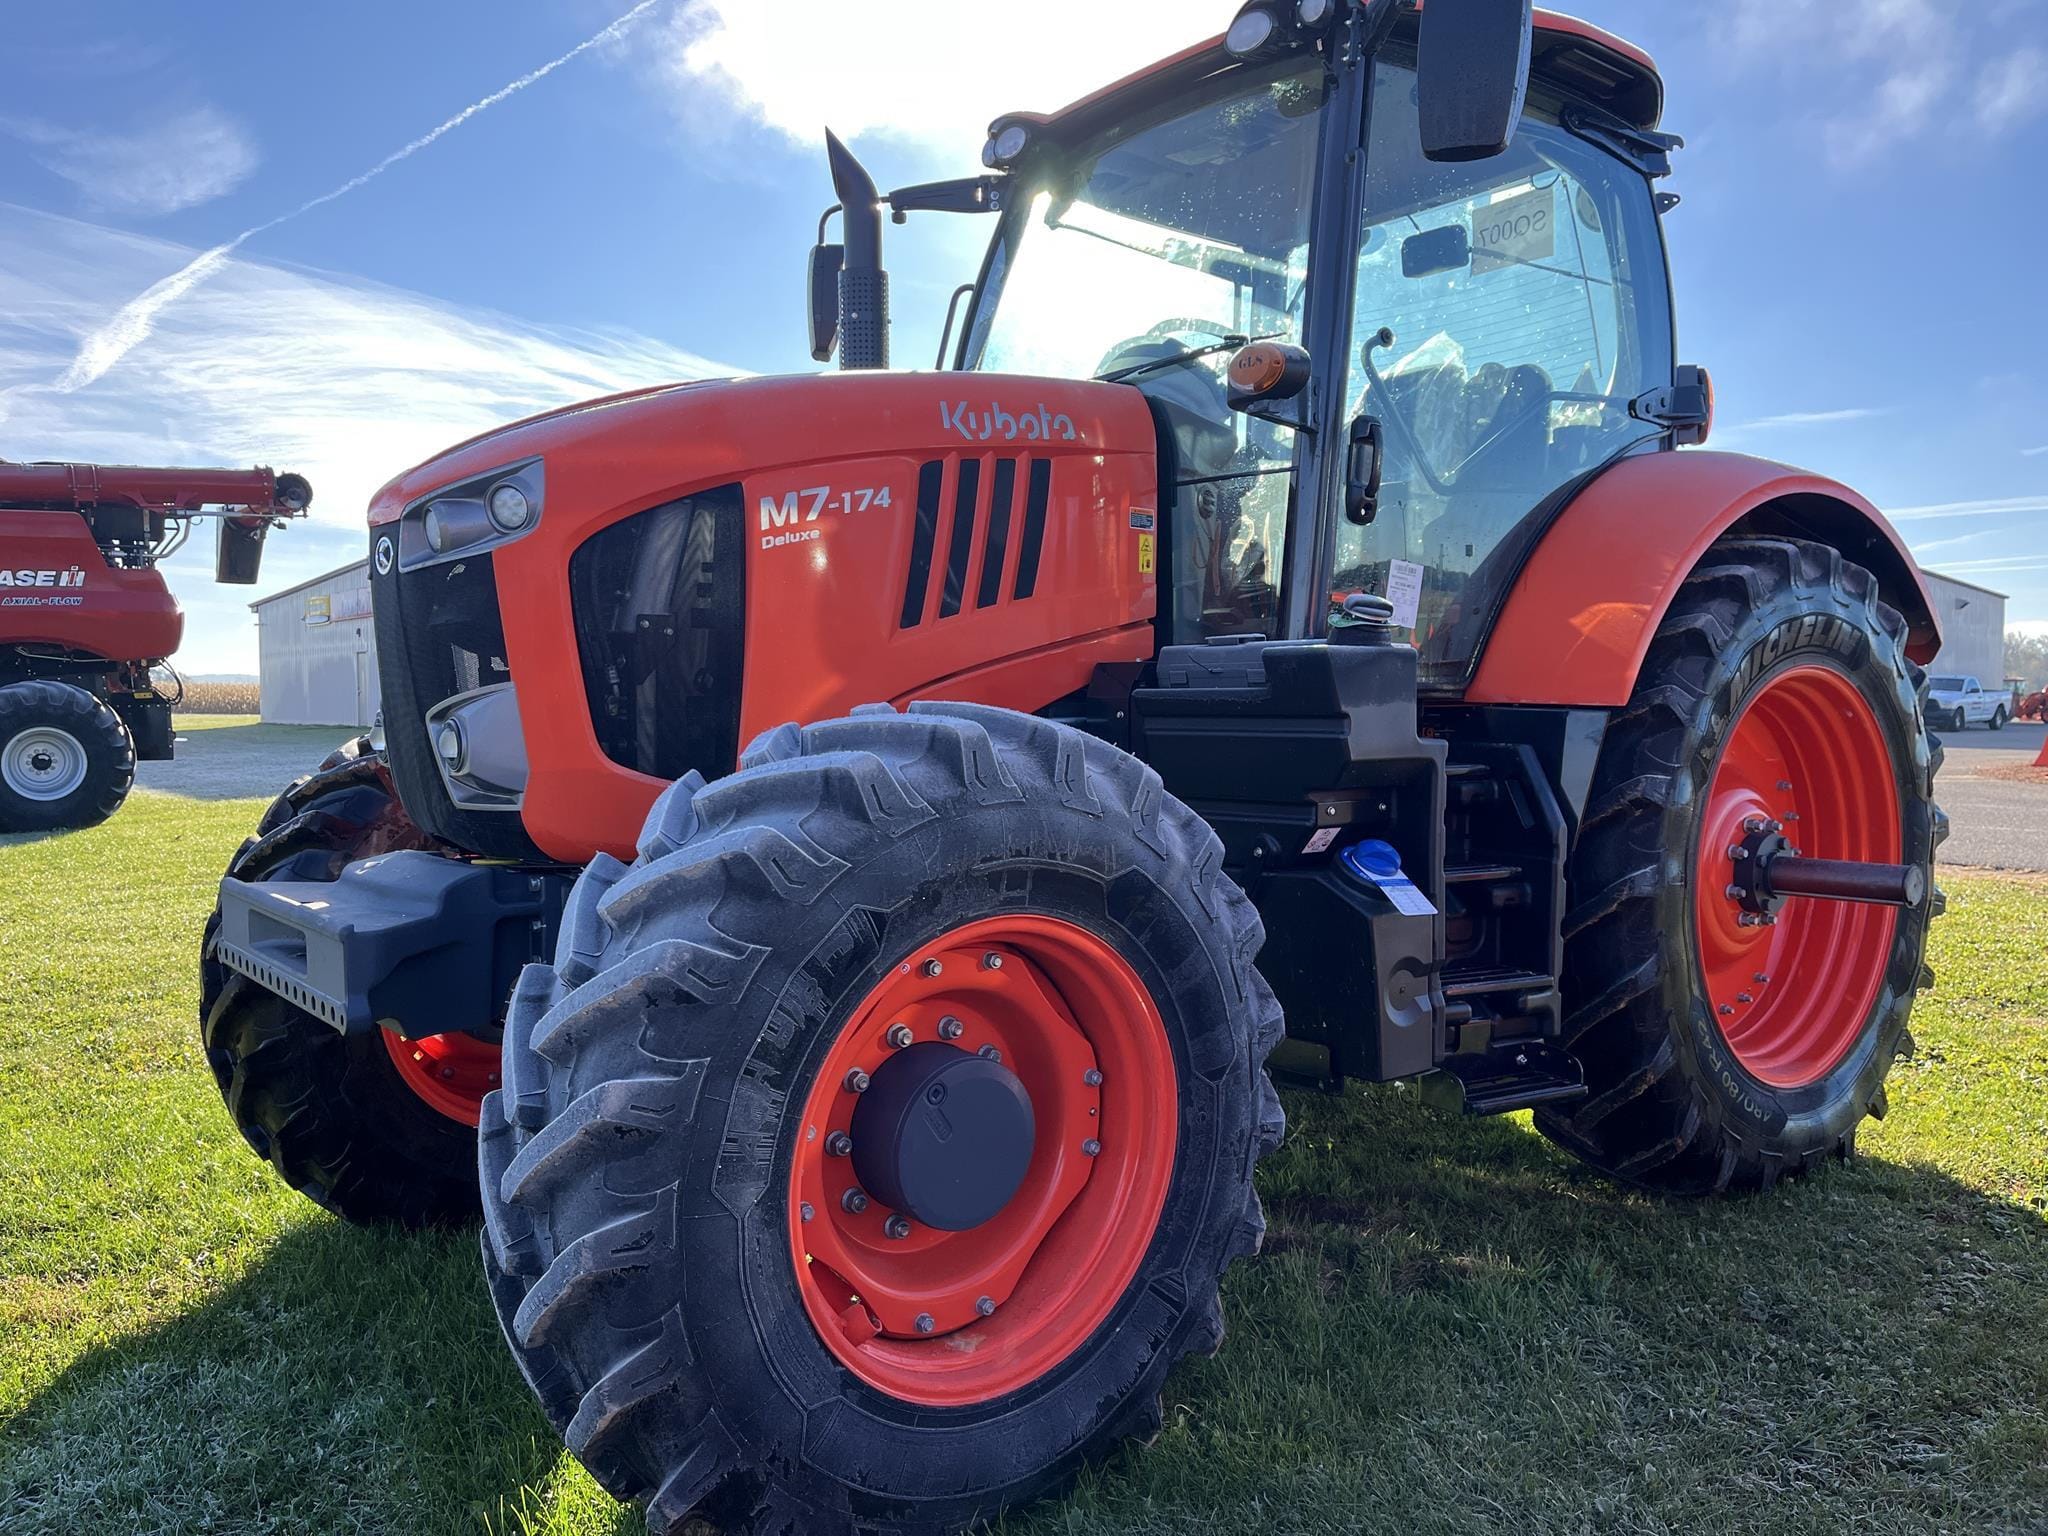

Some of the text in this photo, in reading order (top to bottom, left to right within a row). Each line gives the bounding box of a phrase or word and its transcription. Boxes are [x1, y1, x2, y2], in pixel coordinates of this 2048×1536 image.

[940, 400, 1076, 440] Kubota
[761, 529, 820, 549] Deluxe
[1, 597, 83, 606] AXIAL-FLOW
[1729, 615, 1864, 713] MICHELIN
